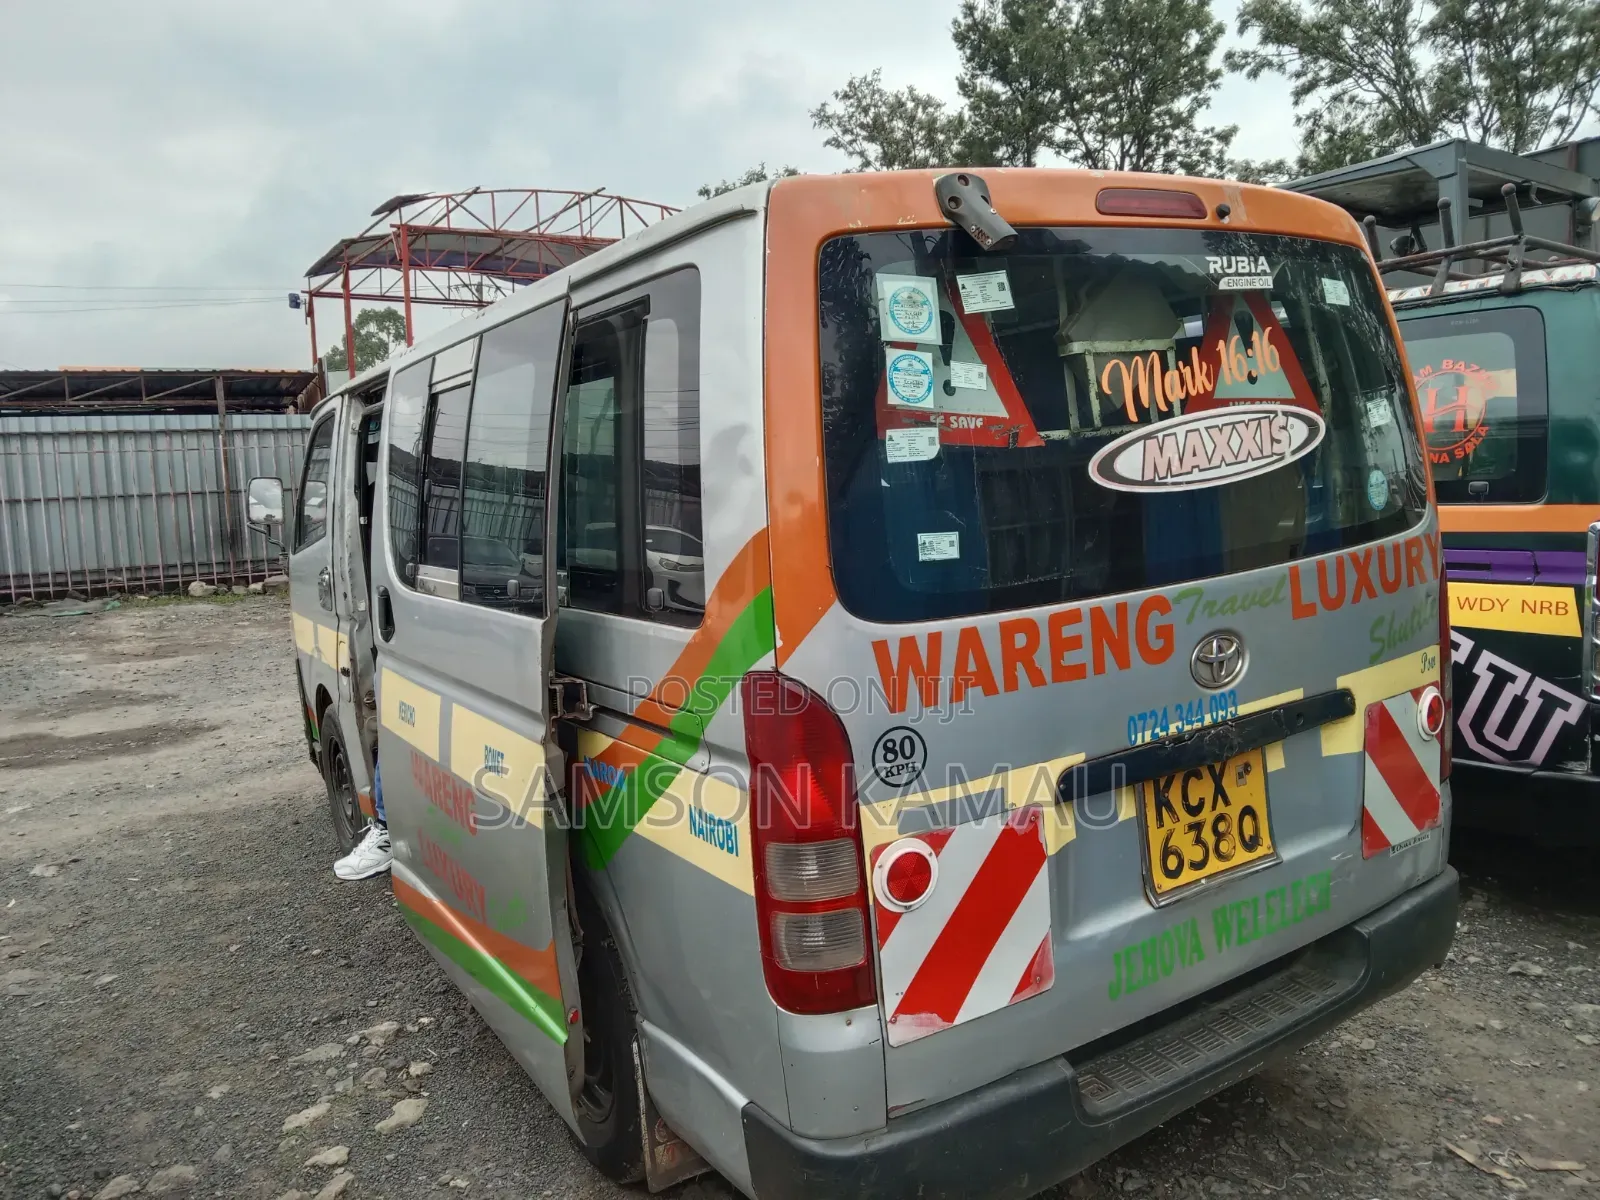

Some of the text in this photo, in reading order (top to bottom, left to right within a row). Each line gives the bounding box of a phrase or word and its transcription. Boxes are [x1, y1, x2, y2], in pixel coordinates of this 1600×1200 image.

[1227, 278, 1271, 287] ENGINE OIL
[1101, 327, 1280, 422] Mark 16:16
[1141, 415, 1291, 481] MAXXIS
[1429, 452, 1451, 464] NA
[871, 594, 1175, 715] WARENG
[1172, 573, 1287, 625] Travel
[1288, 532, 1440, 620] LUXURY
[1457, 596, 1569, 616] WDY NRB
[1127, 689, 1239, 746] 0724 344 093
[882, 735, 916, 764] 80
[884, 761, 917, 778] KPH
[1152, 760, 1232, 829] KCX
[688, 803, 739, 857] NAIROBI
[1159, 804, 1263, 880] 638Q
[1107, 916, 1206, 1002] JEHOVA
